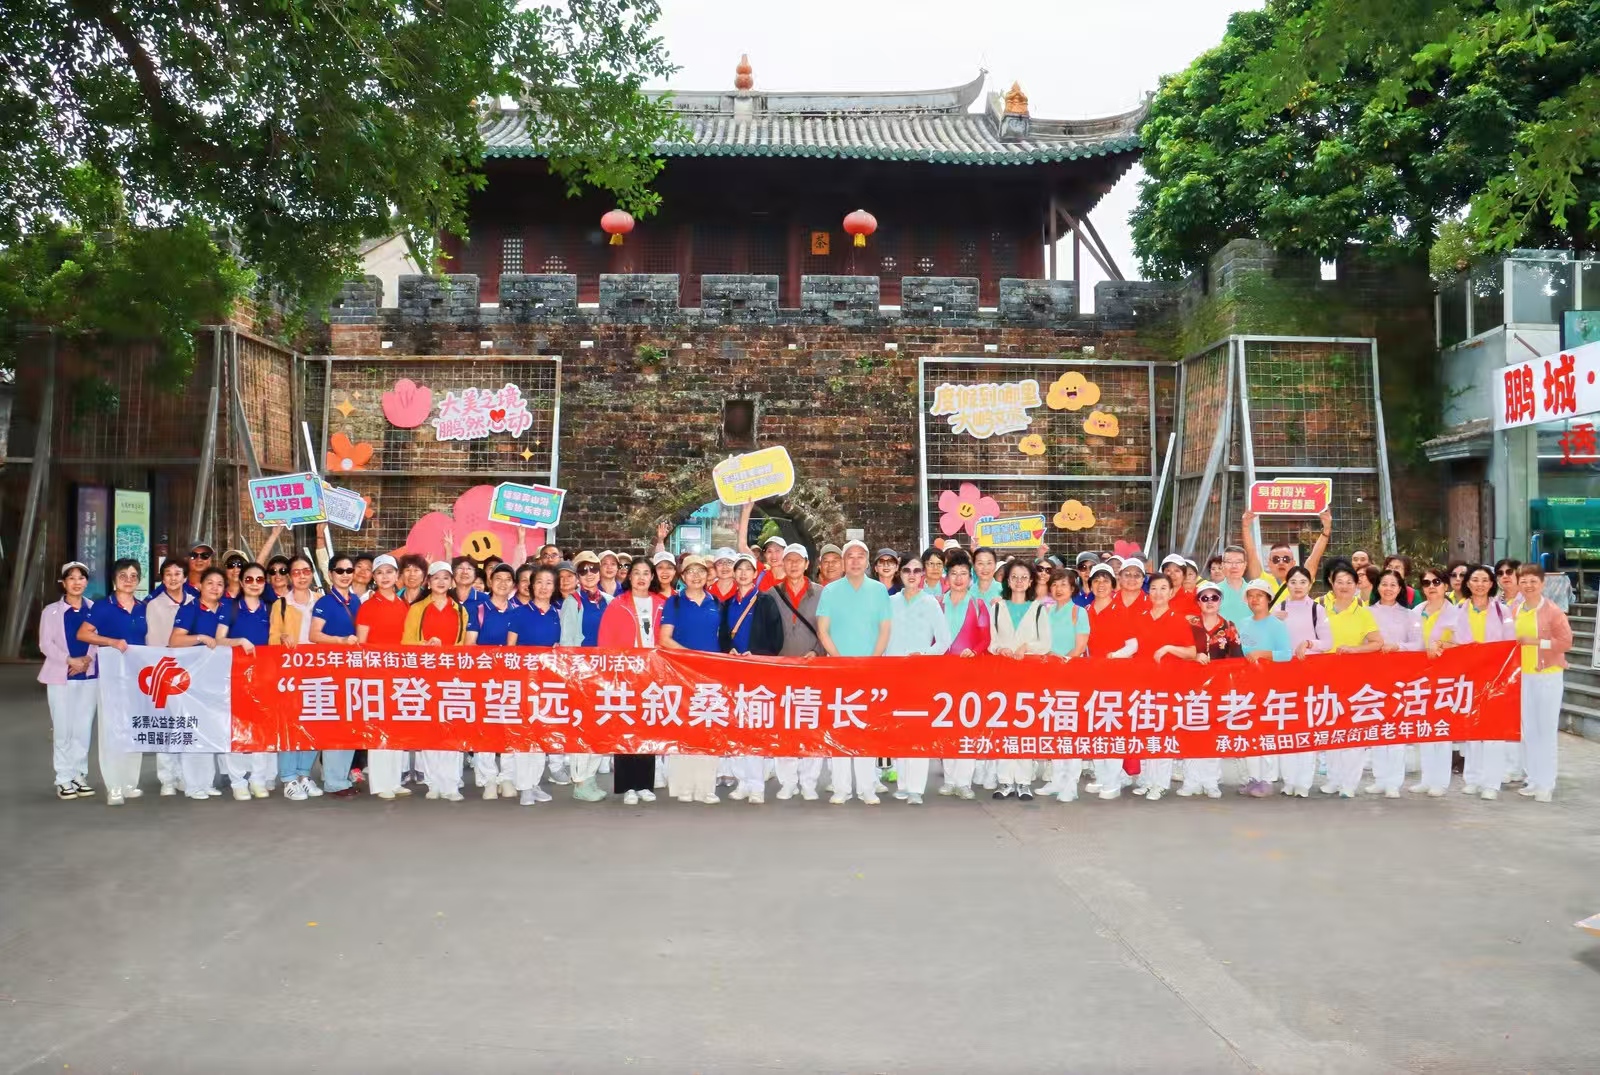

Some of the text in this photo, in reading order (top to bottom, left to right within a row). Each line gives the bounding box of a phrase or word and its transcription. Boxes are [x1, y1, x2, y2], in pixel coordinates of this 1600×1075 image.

[815, 231, 828, 248] 茶
[440, 384, 525, 415] 大美之境
[1558, 422, 1598, 466] 透
[132, 715, 198, 730] 彩票公益金资助
[958, 718, 1451, 755] 主办:福田区福保街道办事处 承办:福田区福保街道老年协会
